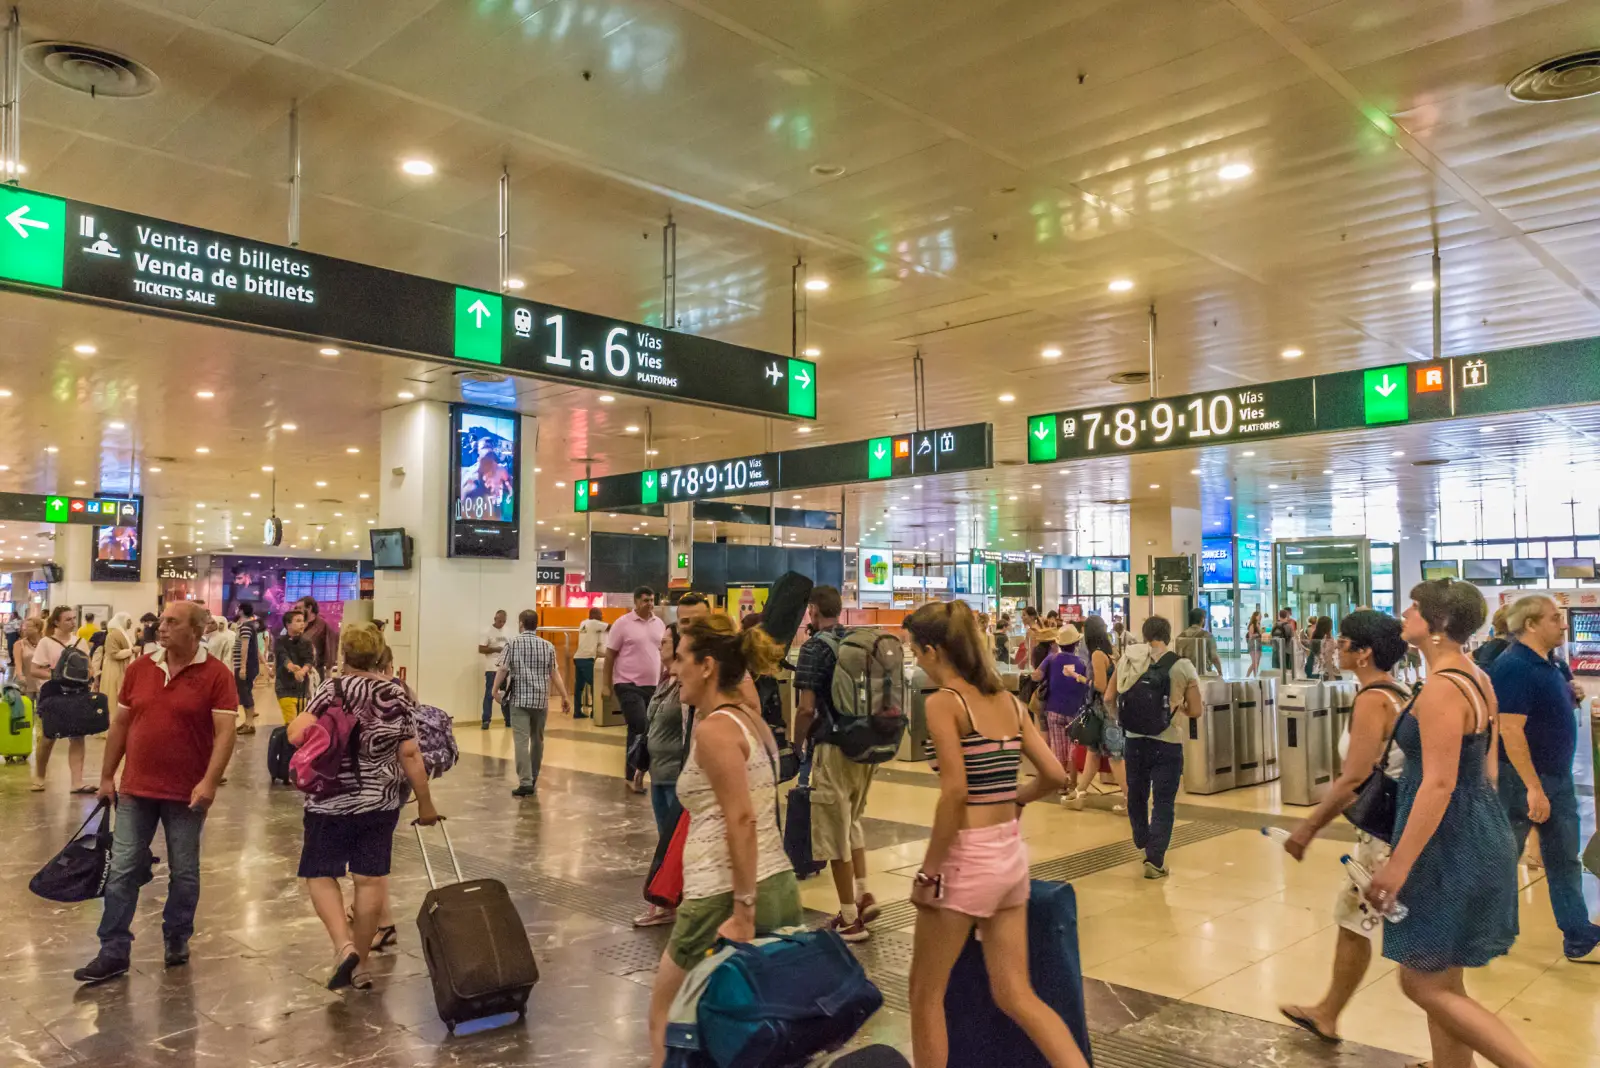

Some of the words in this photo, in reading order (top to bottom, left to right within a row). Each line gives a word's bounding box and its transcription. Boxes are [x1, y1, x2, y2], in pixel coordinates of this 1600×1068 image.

[136, 225, 199, 256] Venta
[206, 240, 232, 263] de
[239, 246, 310, 279] billetes
[134, 251, 204, 283] Venda
[211, 268, 238, 289] de
[244, 274, 314, 304] bitllets
[133, 279, 184, 300] TICKETS
[185, 289, 216, 306] SALE
[545, 314, 572, 368] 1
[579, 349, 595, 372] a
[604, 326, 631, 377] 6
[637, 332, 662, 350] Vías
[637, 352, 662, 370] Vies
[637, 372, 678, 388] PLATFORMS
[1426, 370, 1442, 386] R
[1239, 390, 1264, 405] Vías
[1239, 406, 1265, 421] Vies
[1238, 419, 1280, 433] PLATFORMS
